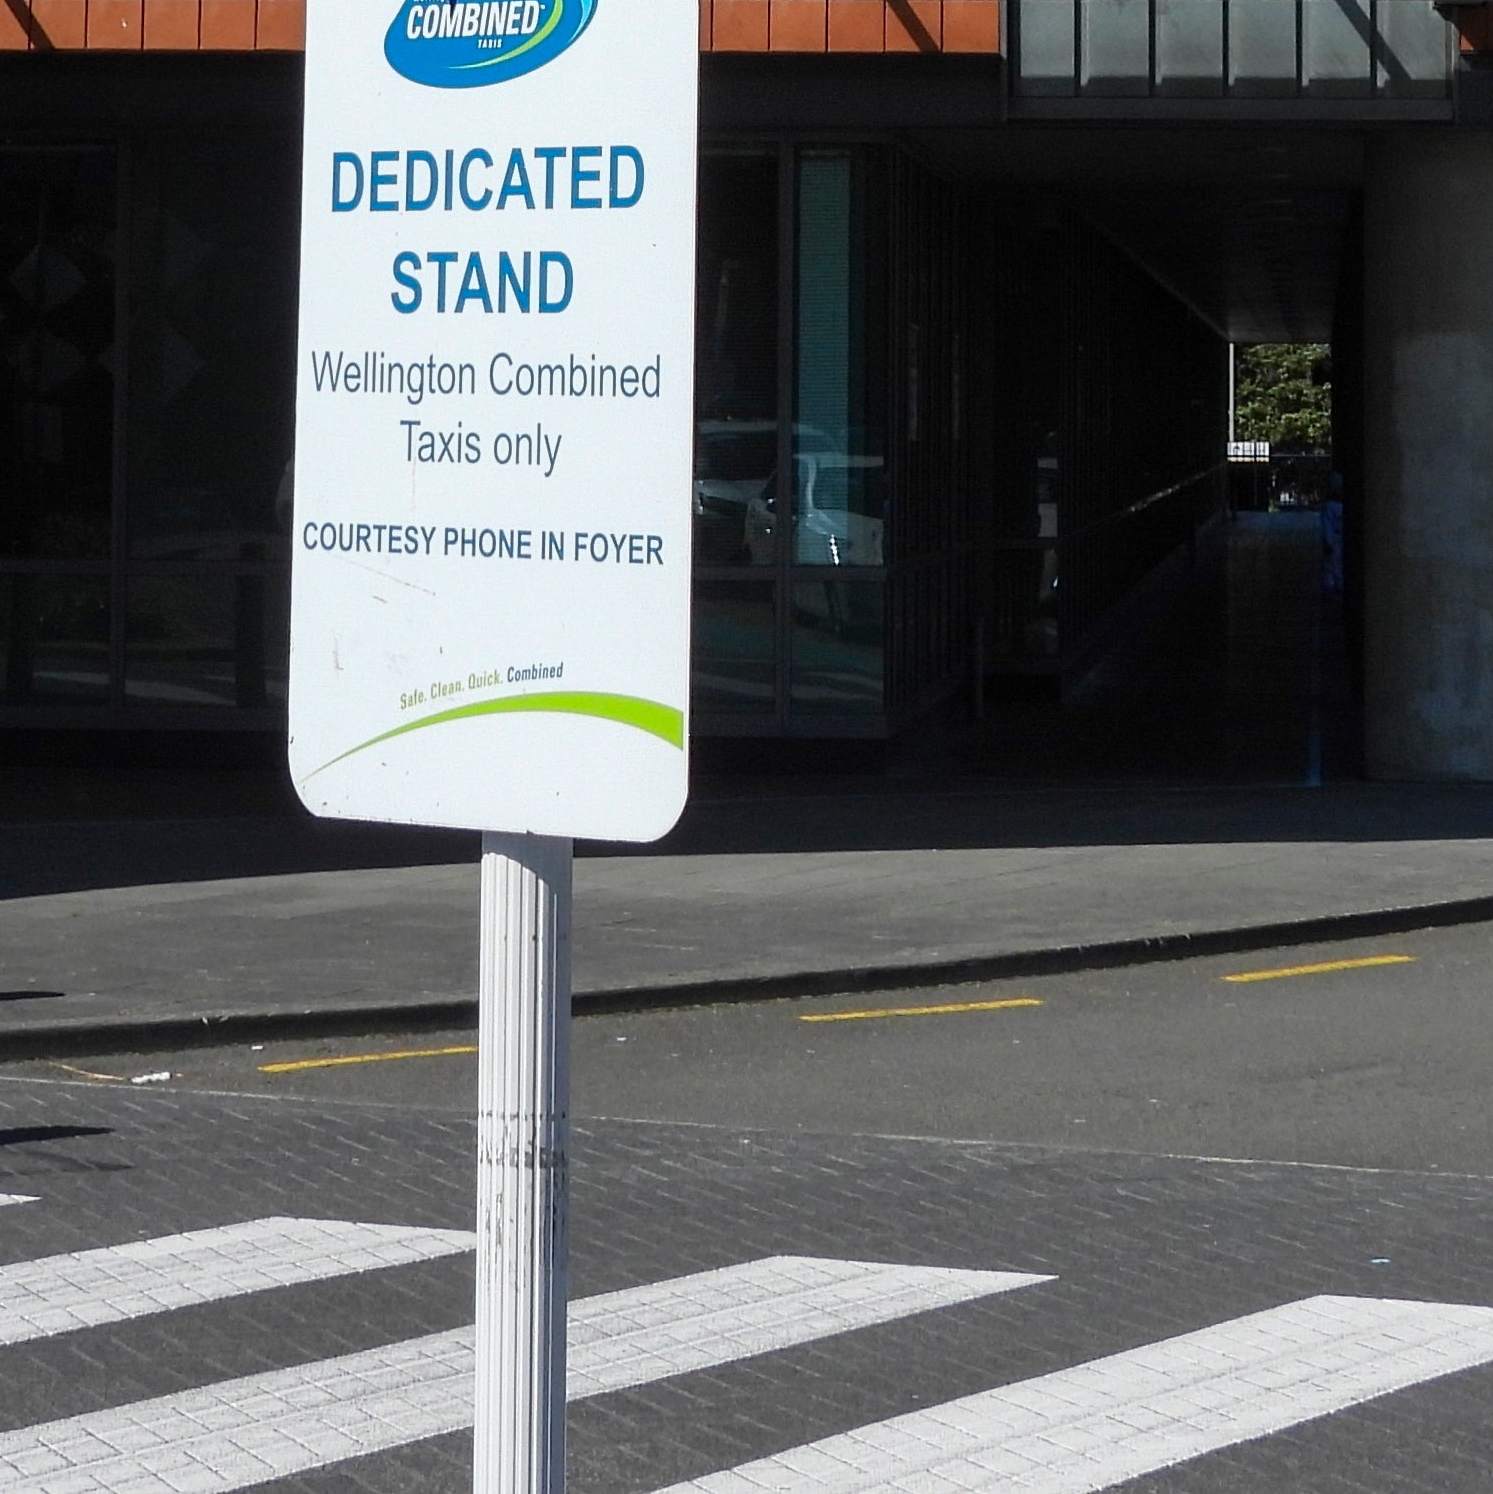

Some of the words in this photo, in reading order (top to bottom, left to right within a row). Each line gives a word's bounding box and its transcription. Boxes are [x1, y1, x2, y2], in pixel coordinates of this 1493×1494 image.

[407, 0, 540, 40] COMBINED
[331, 145, 645, 212] DEDICATED
[390, 251, 574, 314] STAND
[311, 350, 476, 405] Wellington
[489, 352, 661, 398] Combined
[400, 420, 482, 464] Taxis
[493, 422, 562, 478] only
[303, 521, 437, 555] COURTESY
[443, 527, 532, 559] PHONE
[540, 531, 565, 561] IN
[573, 532, 664, 565] FOYER
[400, 688, 427, 710] Safe.
[430, 680, 465, 700] Clean.
[468, 669, 504, 690] Quick.
[507, 661, 564, 683] Combined
